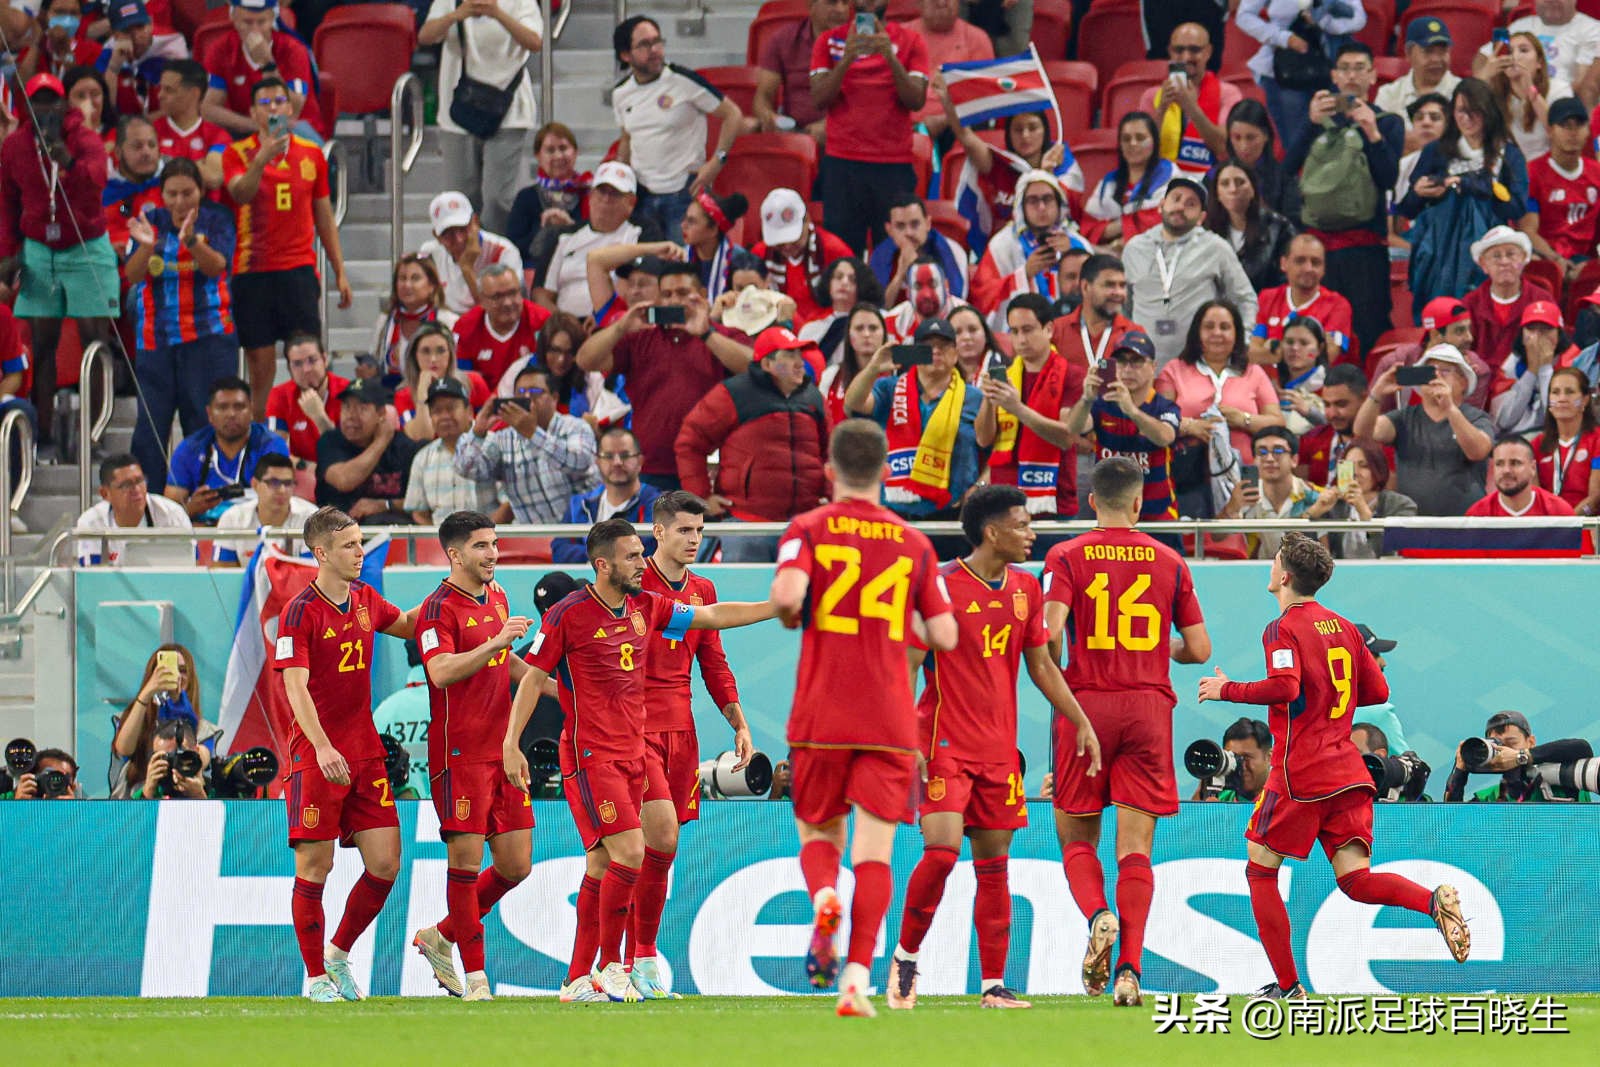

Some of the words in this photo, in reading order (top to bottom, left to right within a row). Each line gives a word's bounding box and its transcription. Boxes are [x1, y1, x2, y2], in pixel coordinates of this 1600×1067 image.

[277, 183, 291, 211] 6
[1022, 471, 1054, 483] CSR
[827, 515, 904, 544] LAPORTE
[1084, 545, 1155, 561] RODRIGO
[815, 543, 914, 642] 24
[1085, 572, 1161, 651] 16
[338, 639, 365, 672] 21
[620, 642, 634, 671] 8
[982, 623, 1012, 657] 14
[1327, 646, 1352, 719] 9
[140, 800, 1505, 997] Hisense
